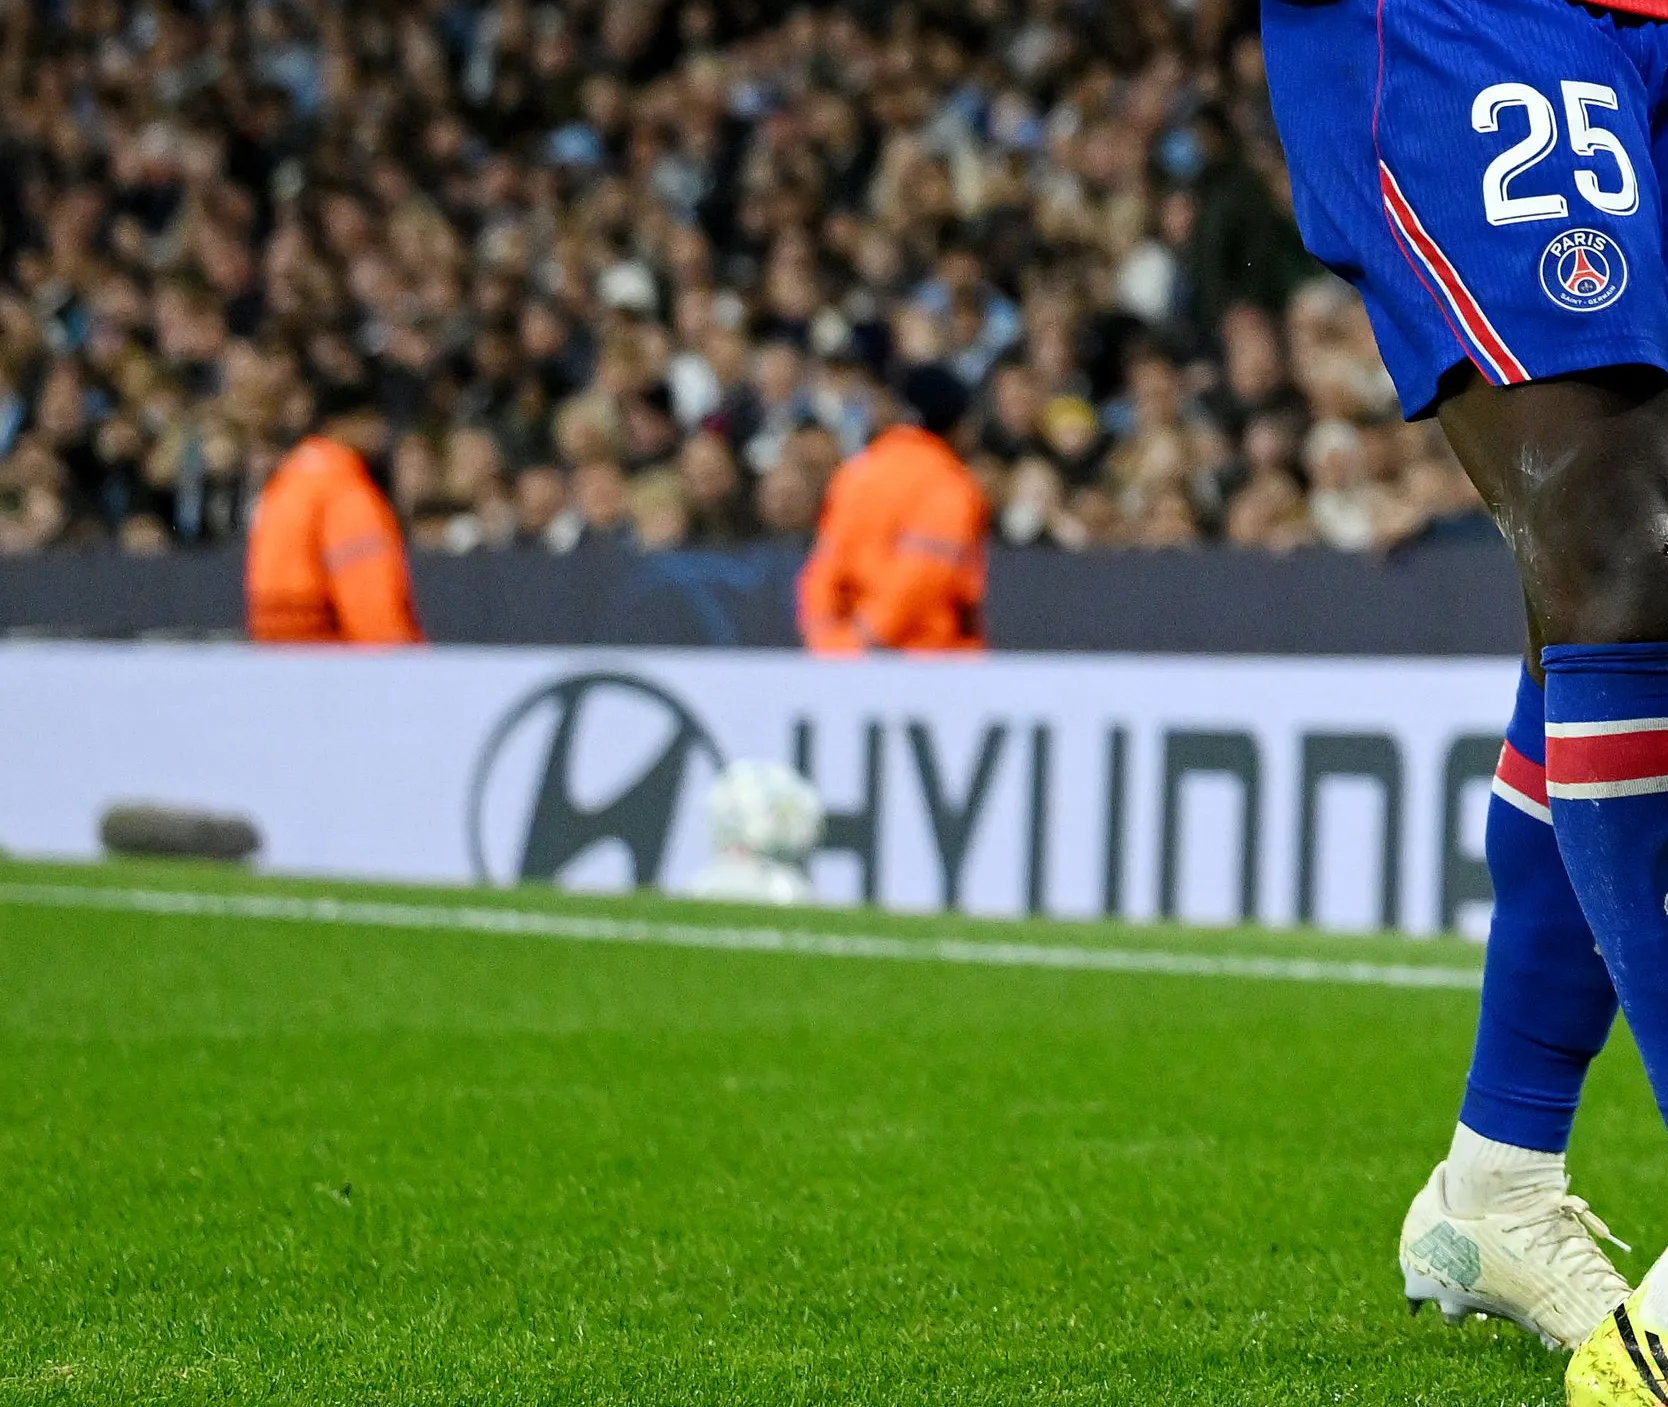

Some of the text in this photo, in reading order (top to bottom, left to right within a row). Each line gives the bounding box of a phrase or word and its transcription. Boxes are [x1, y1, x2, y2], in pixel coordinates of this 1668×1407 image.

[1471, 80, 1640, 227] 25
[1550, 232, 1607, 258] PARIS
[792, 714, 1506, 934] HYUNDA
